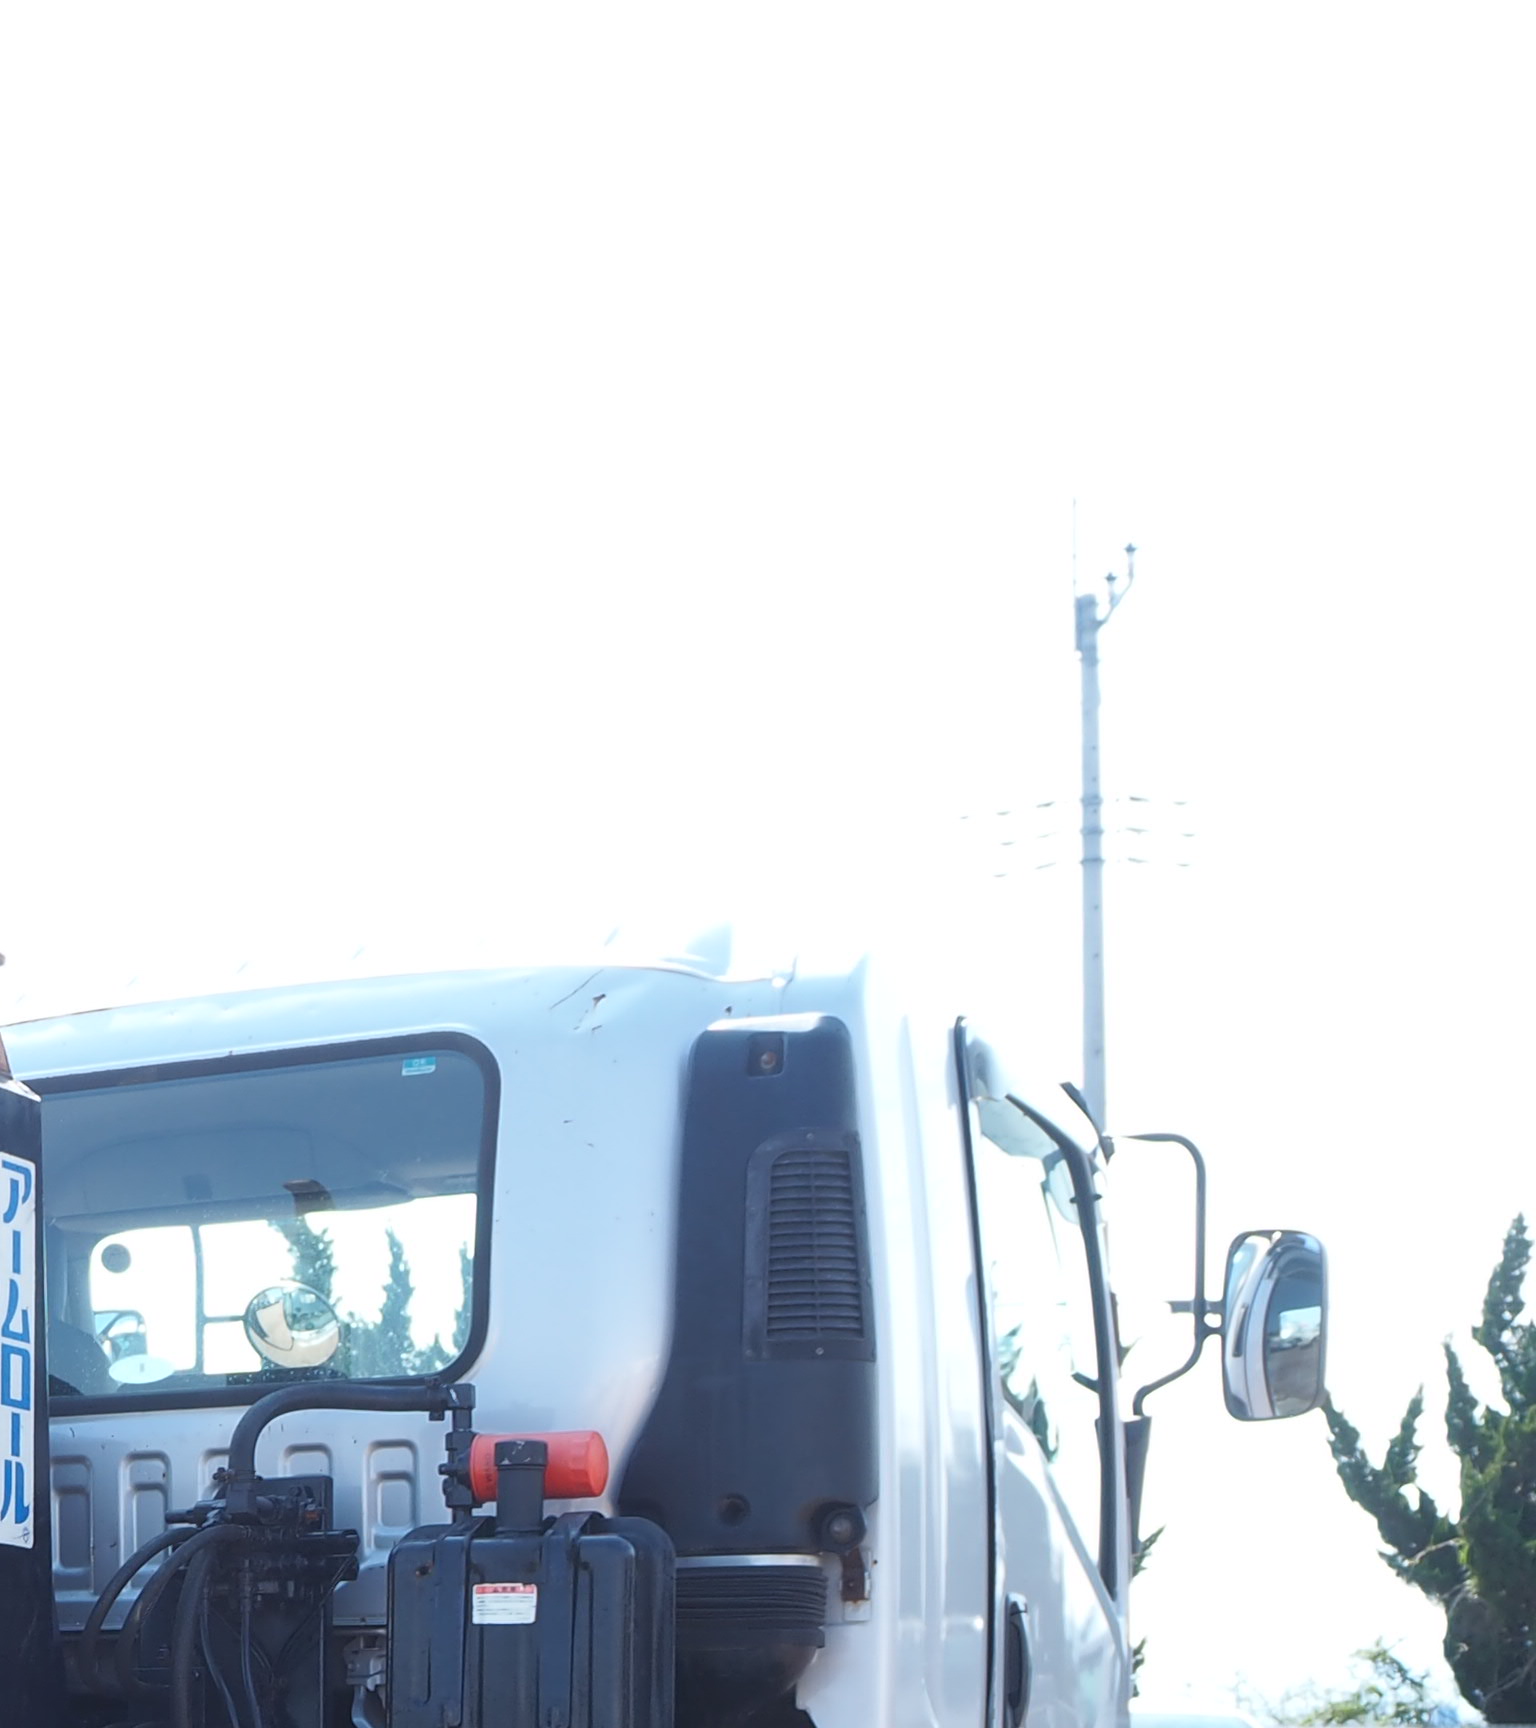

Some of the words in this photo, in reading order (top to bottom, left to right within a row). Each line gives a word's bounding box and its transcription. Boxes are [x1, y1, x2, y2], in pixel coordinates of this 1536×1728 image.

[0, 1159, 32, 1525] アームロール
